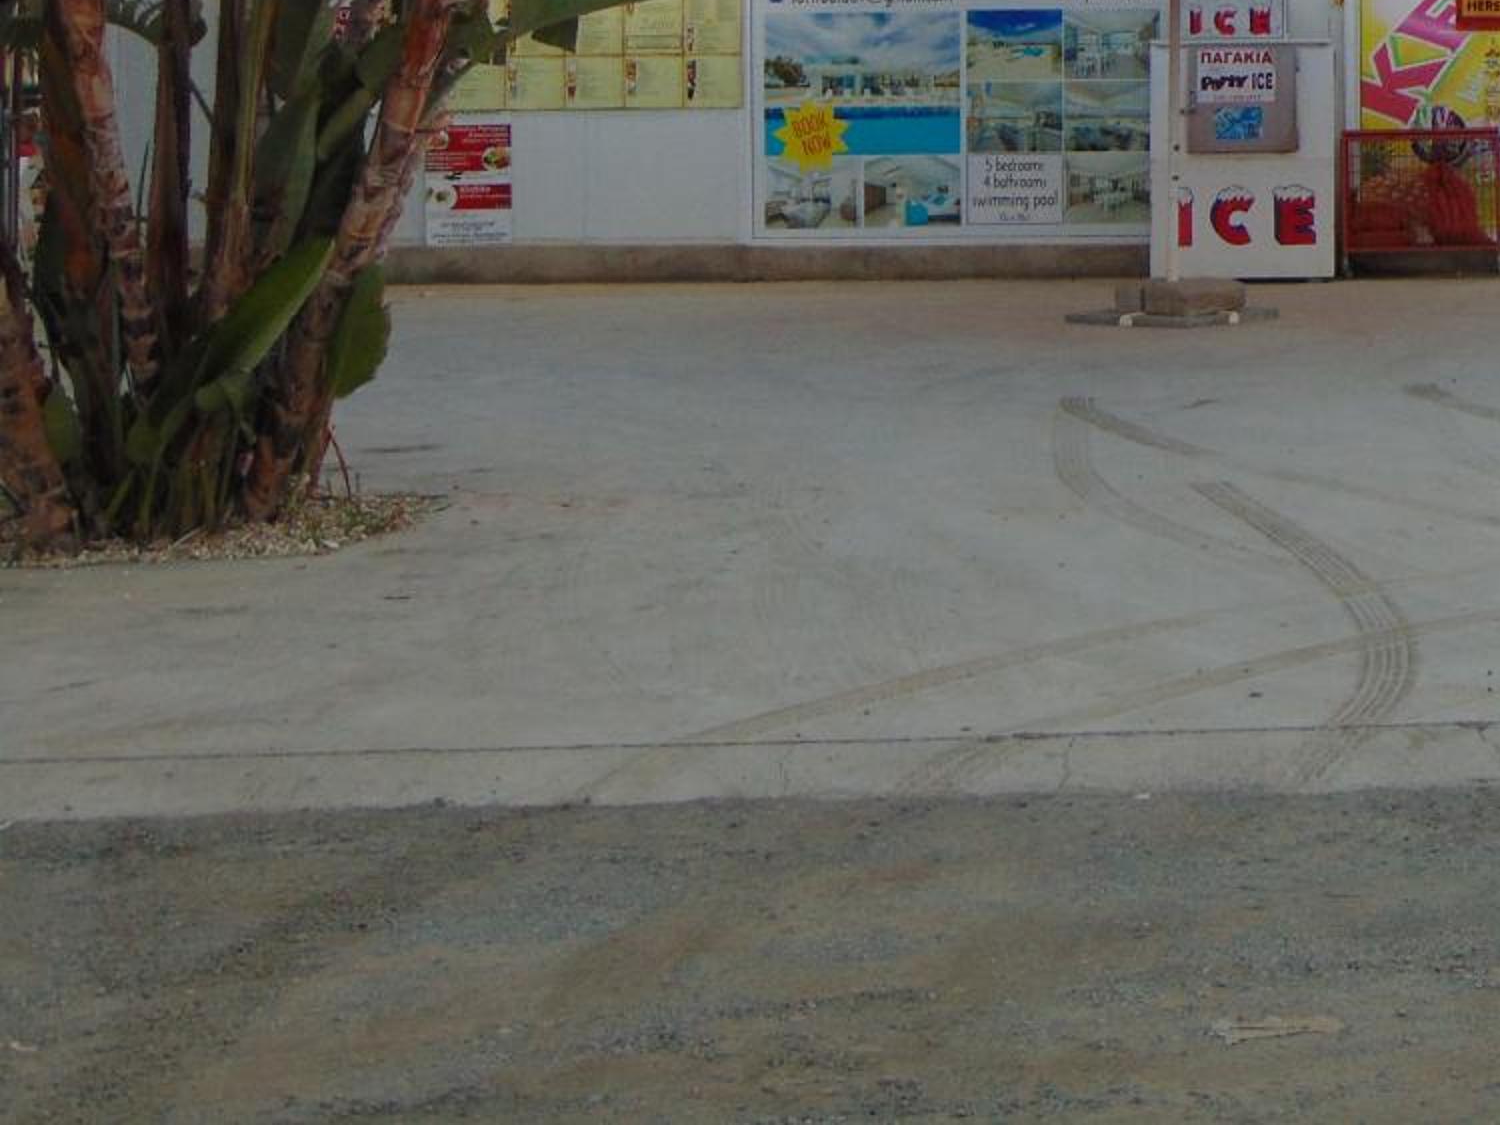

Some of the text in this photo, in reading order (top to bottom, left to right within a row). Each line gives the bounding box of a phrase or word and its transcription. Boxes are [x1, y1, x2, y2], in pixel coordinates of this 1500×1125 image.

[1467, 0, 1500, 12] HERE
[1251, 72, 1274, 91] ICE
[1172, 184, 1318, 248] ICE
